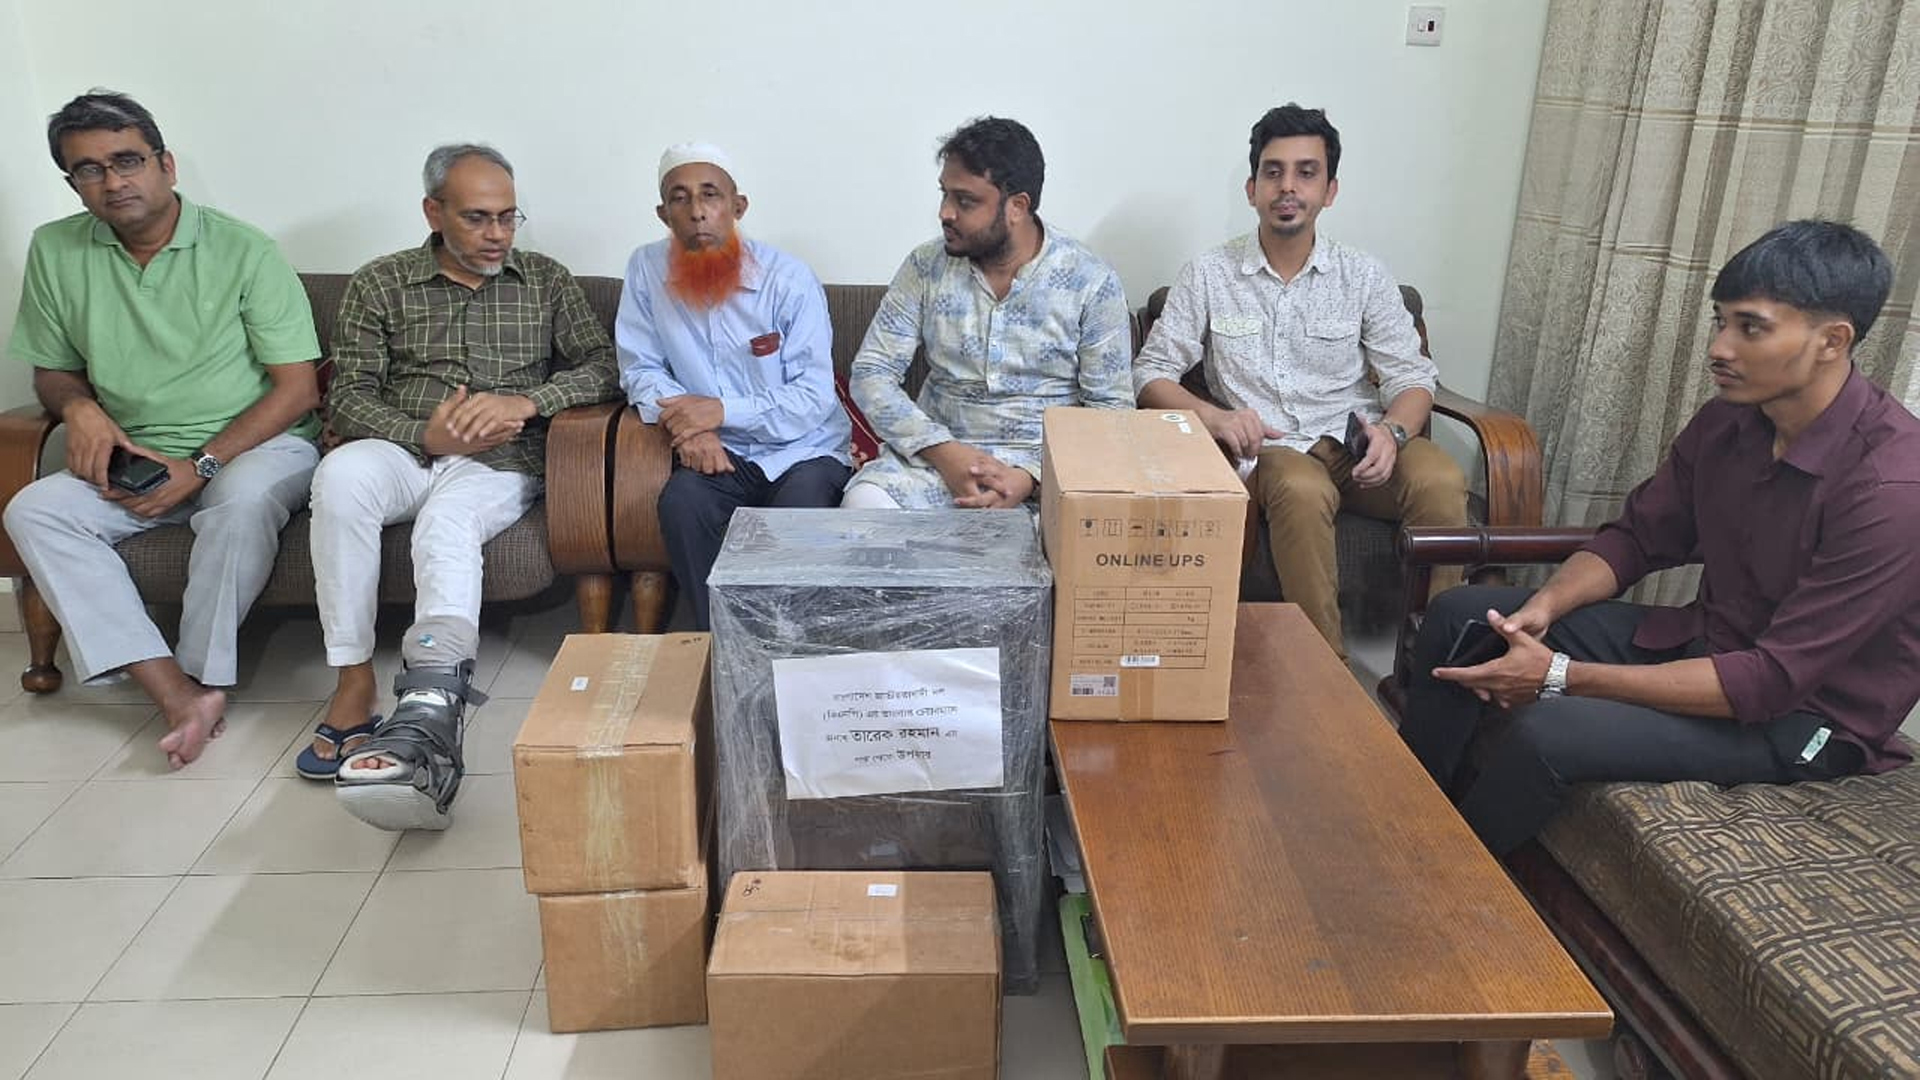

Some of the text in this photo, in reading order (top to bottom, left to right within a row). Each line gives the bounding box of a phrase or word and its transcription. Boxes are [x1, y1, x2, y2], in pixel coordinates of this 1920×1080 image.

[1096, 553, 1206, 567] ONLINE UPS
[848, 730, 894, 743] তারেক
[896, 727, 940, 739] রহমান
